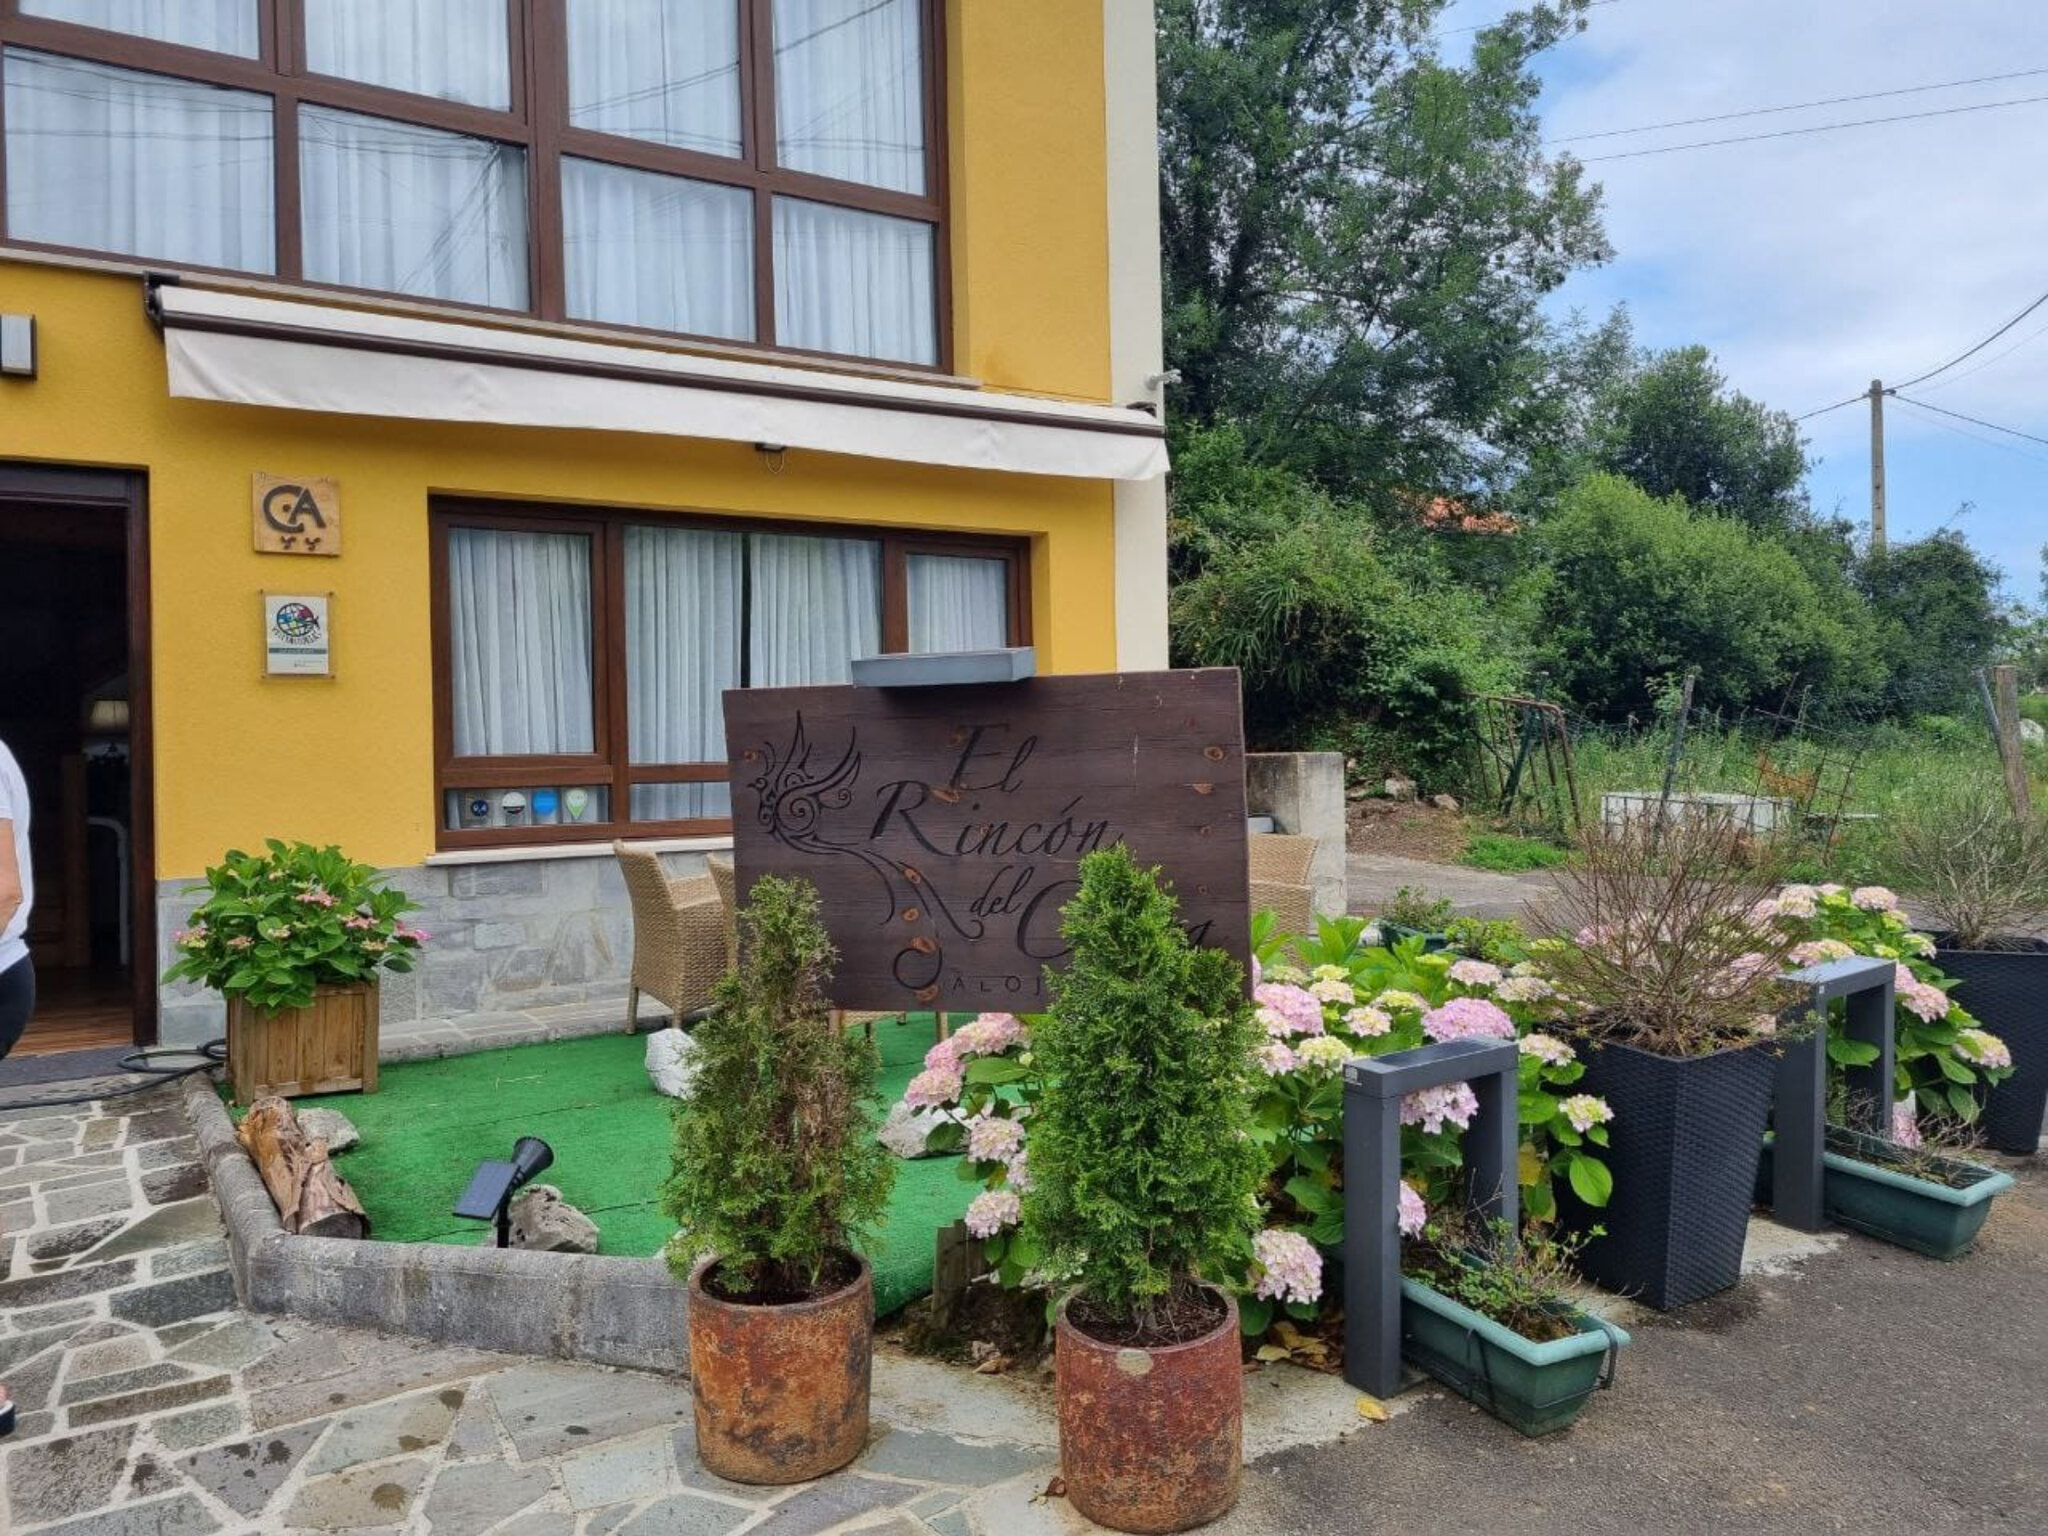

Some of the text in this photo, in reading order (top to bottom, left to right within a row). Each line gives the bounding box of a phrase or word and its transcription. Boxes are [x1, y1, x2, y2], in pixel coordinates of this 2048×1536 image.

[950, 723, 1038, 793] El
[869, 780, 1124, 857] Rincón
[969, 865, 1035, 918] del
